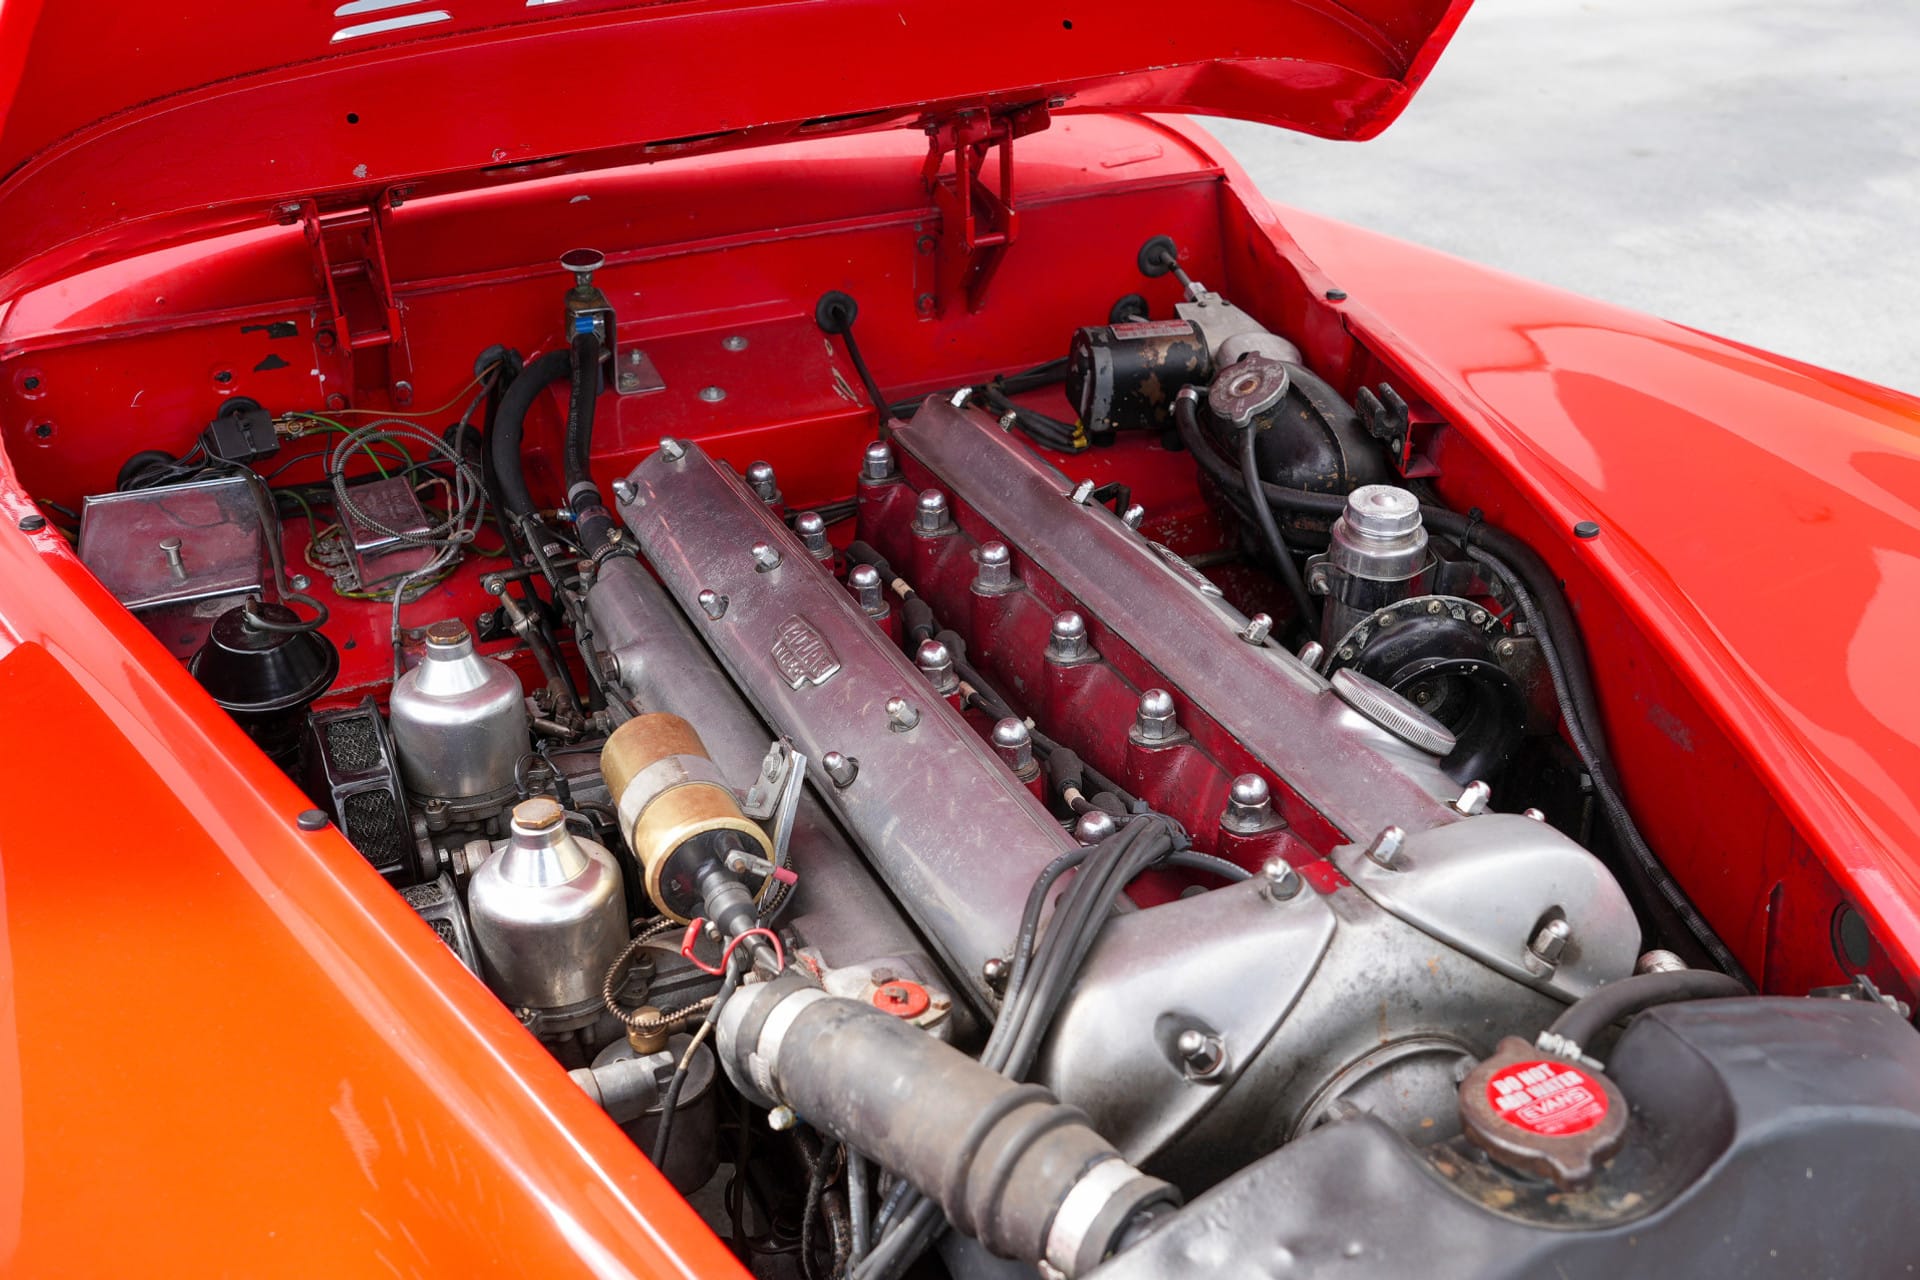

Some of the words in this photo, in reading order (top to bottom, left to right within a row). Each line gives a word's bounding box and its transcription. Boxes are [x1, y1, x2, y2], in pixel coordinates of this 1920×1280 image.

[1492, 1076, 1524, 1095] DO
[1517, 1063, 1556, 1086] NOT
[1495, 1090, 1533, 1111] ADD
[1526, 1070, 1585, 1097] WATER
[1521, 1089, 1586, 1118] EVANS
